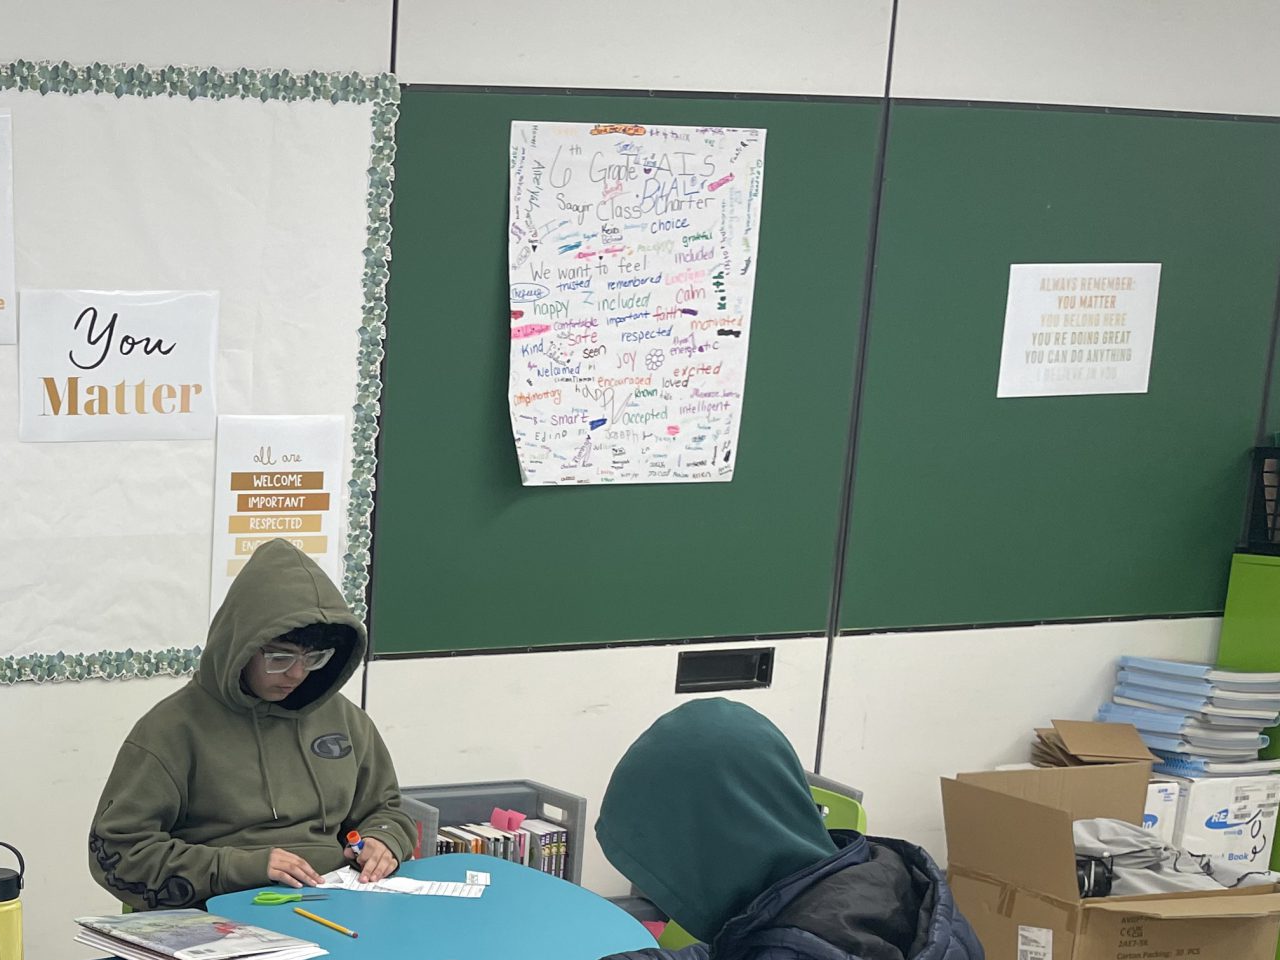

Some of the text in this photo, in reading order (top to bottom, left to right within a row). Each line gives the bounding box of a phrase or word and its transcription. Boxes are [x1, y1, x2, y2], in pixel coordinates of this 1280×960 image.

[650, 217, 690, 234] choice
[530, 260, 551, 281] We
[1040, 277, 1078, 291] ALWAYS
[533, 299, 570, 320] happy
[597, 292, 651, 311] included
[1058, 295, 1117, 309] YOU MATTER
[1040, 313, 1060, 327] YOU
[69, 306, 177, 370] You
[621, 325, 674, 343] respected
[1070, 331, 1100, 345] DOING
[1102, 330, 1132, 344] GREAT
[582, 344, 607, 359] seen
[1024, 348, 1132, 364] YOU CAN DO ANYTHING
[673, 360, 723, 377] excited
[662, 375, 690, 388] loved
[38, 376, 203, 417] Matter
[622, 405, 668, 425] accepted
[253, 445, 302, 466] all are
[252, 474, 303, 487] WELCOME
[248, 496, 306, 509] IMPORTANT
[249, 517, 303, 530] RESPECTED
[1227, 852, 1249, 861] Book
